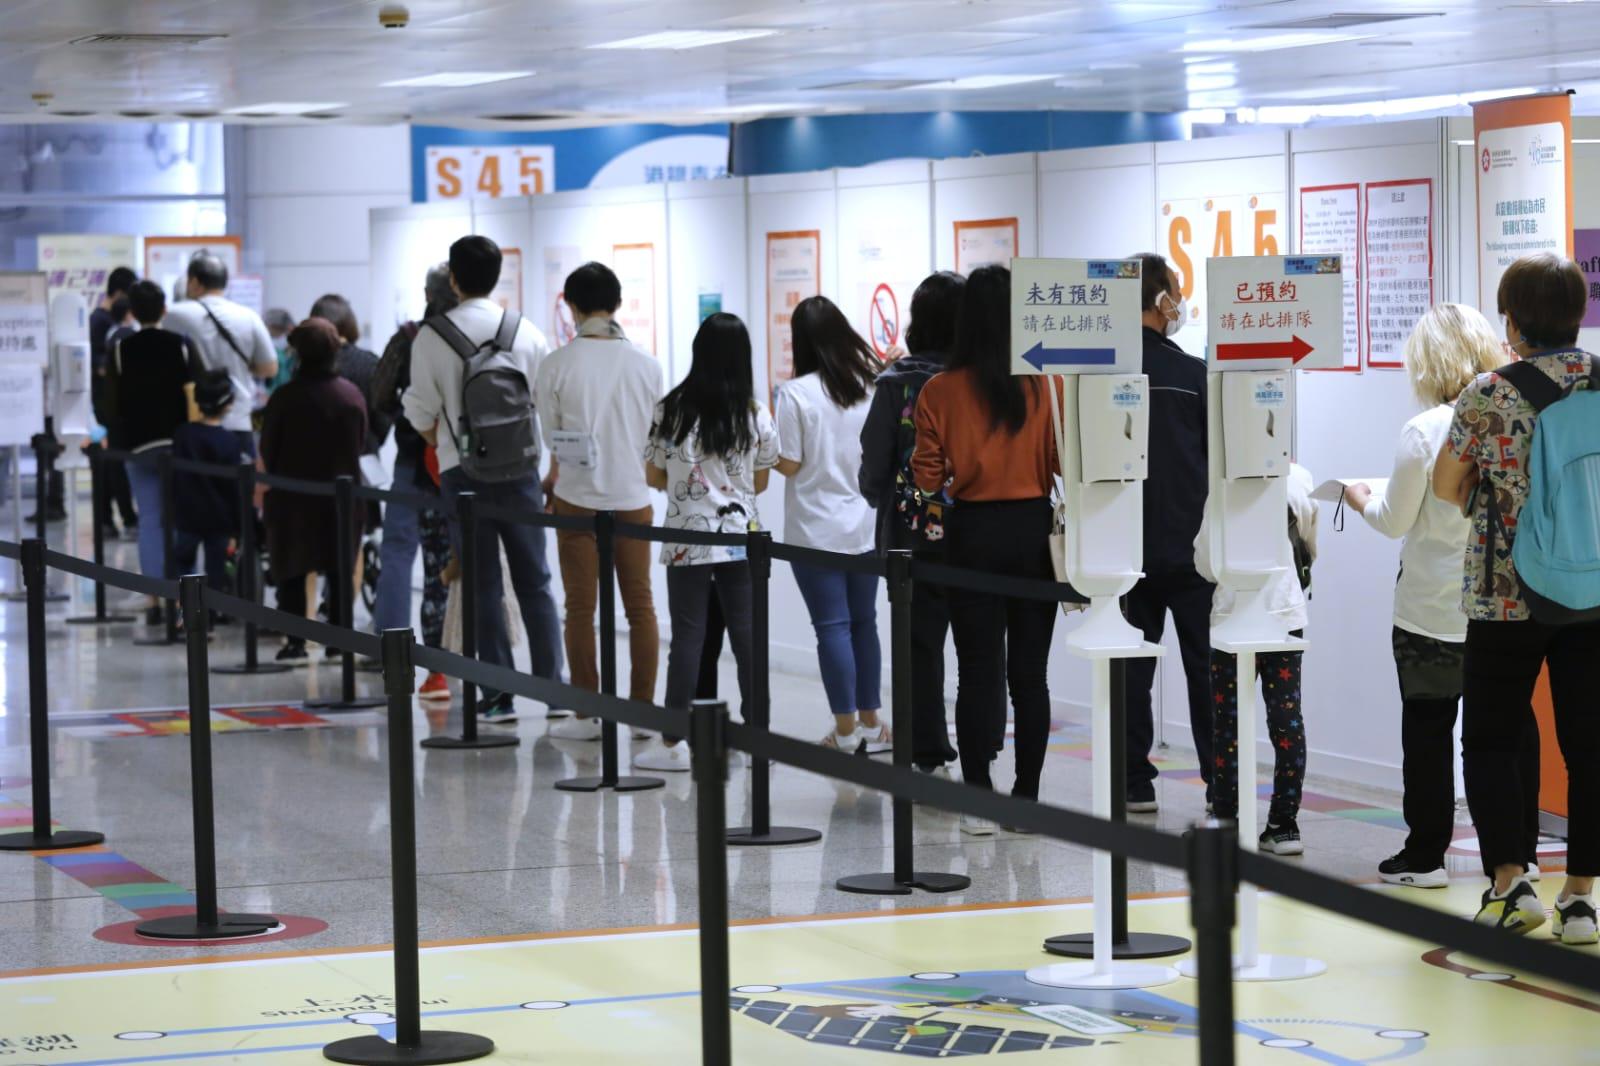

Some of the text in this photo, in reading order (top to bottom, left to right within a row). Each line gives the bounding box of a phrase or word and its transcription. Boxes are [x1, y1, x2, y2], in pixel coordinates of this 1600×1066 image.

[1026, 283, 1108, 303] 未有預約
[1237, 281, 1297, 302] 已預約
[1023, 313, 1113, 333] 請在此排隊
[1220, 309, 1313, 330] 請在此排隊
[260, 997, 449, 1017] Sheung Sui
